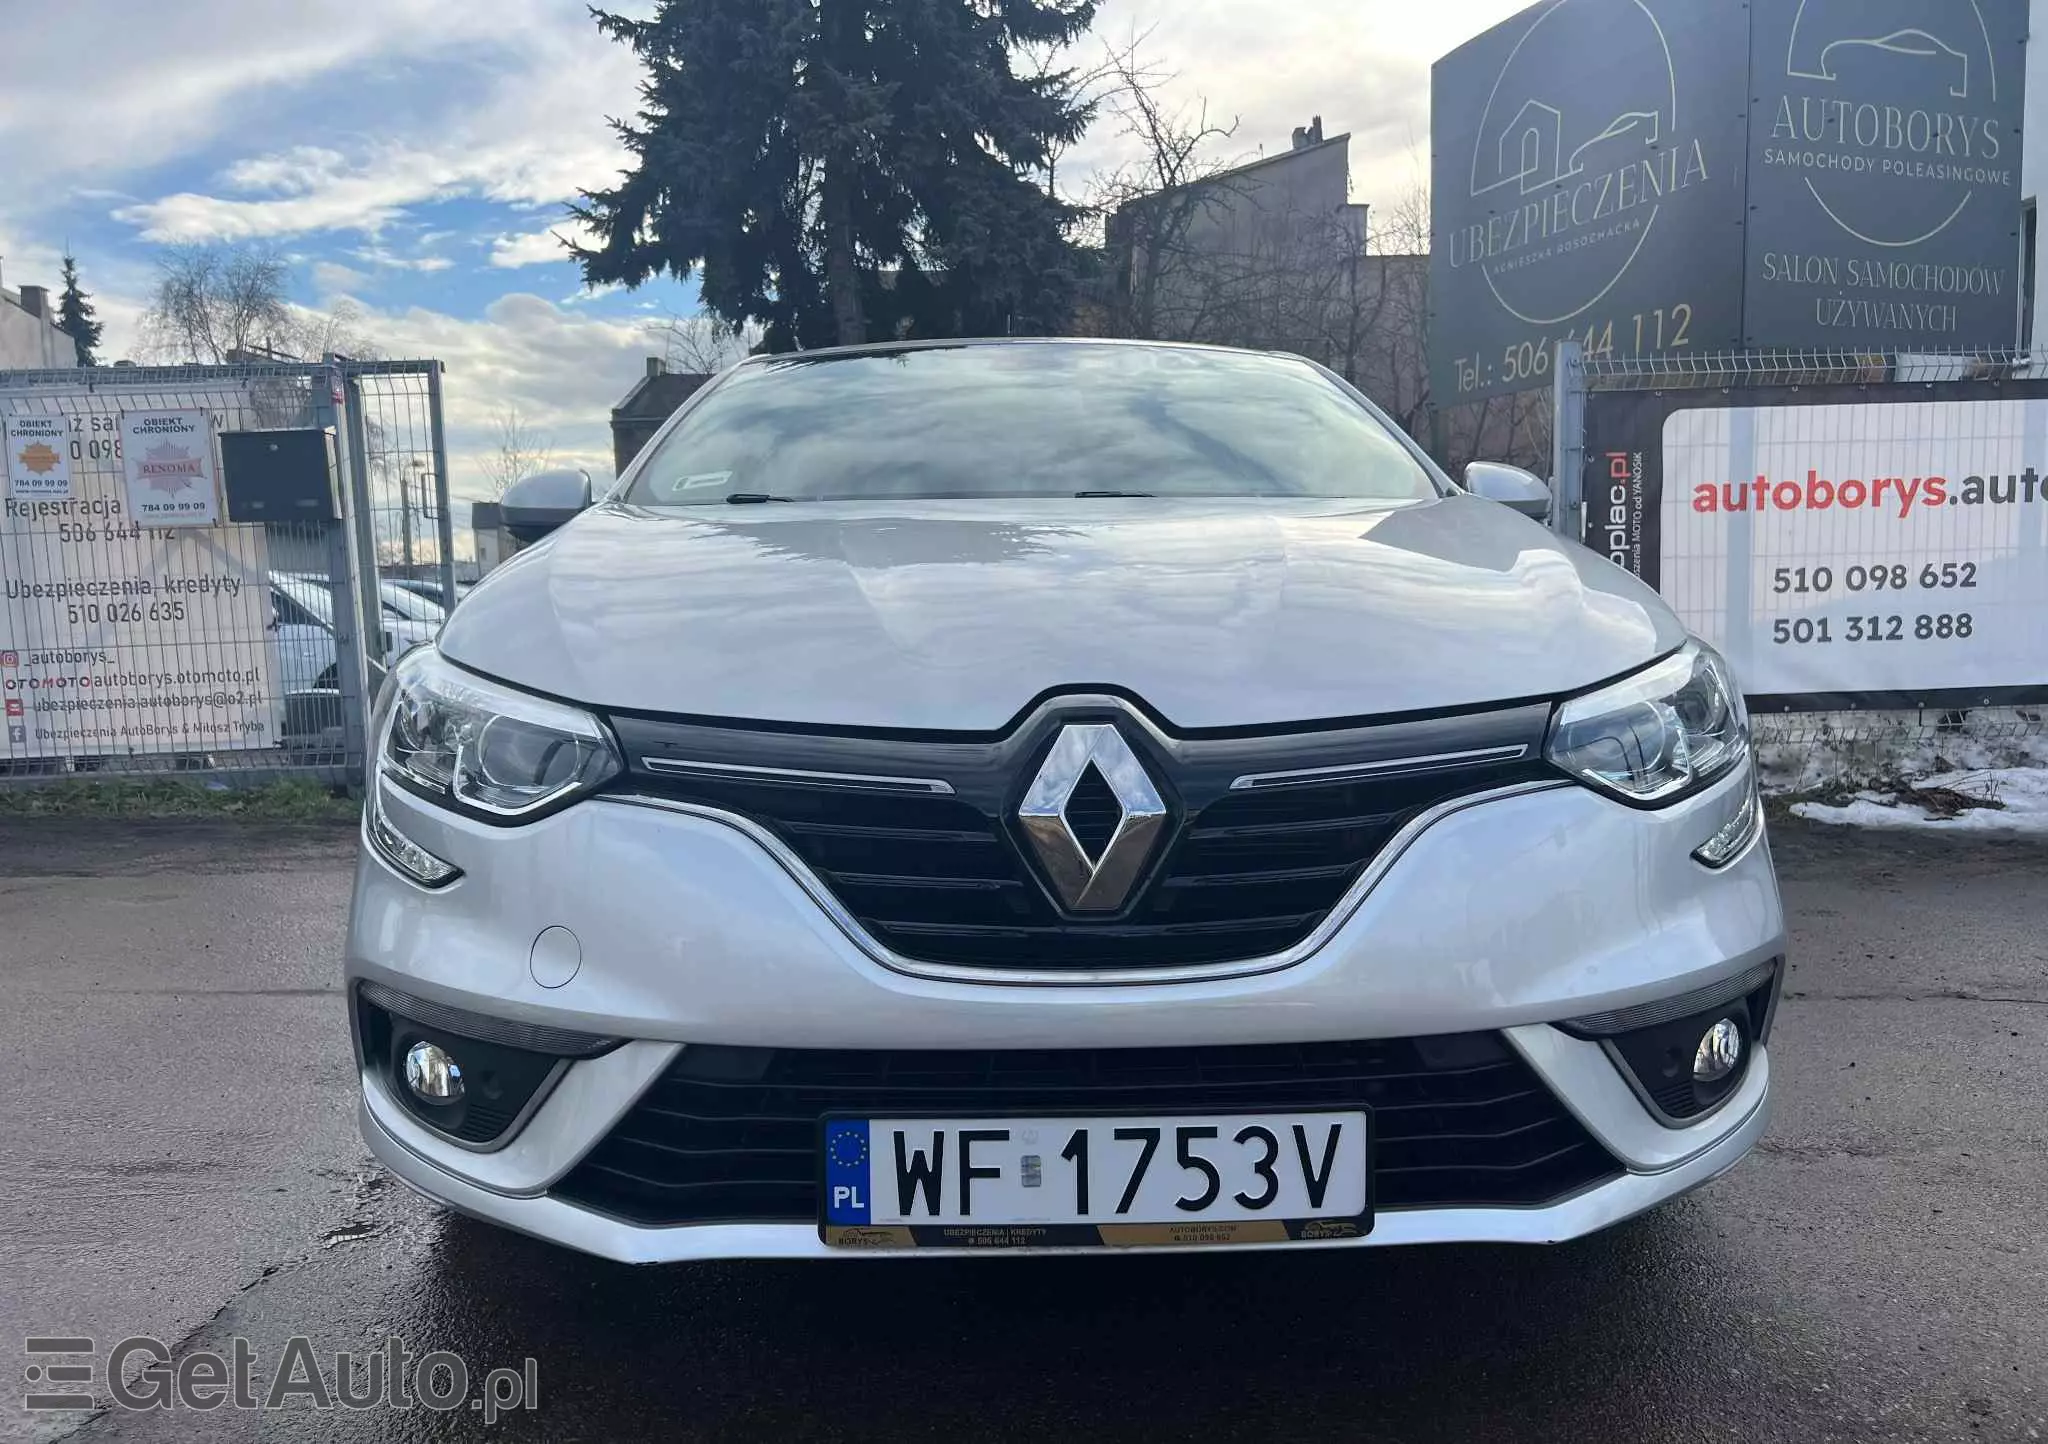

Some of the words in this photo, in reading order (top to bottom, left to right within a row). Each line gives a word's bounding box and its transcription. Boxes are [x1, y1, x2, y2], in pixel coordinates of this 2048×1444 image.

[1771, 95, 2000, 159] AUTOBORYS
[1764, 149, 1874, 173] SAMOCHODY
[1883, 160, 2012, 186] POLEASINGOWE
[1450, 138, 1708, 268] UBEZPIECZENIA
[1763, 253, 1839, 284] SALON
[1846, 259, 2005, 295] SAMOCHODÓW
[1816, 290, 1958, 331] UŻYWANYCH
[1454, 353, 1493, 392] Tel.:
[1501, 337, 1549, 383] 506
[1568, 320, 1614, 361] 44
[1632, 304, 1692, 352] 112
[11, 429, 63, 437] CHRONIONY
[20, 420, 52, 428] OBIEKT
[132, 425, 195, 434] CHRONIONY
[144, 417, 183, 426] OBIEKT
[143, 464, 196, 474] RENOMA
[1632, 452, 1643, 494] YANOSIK
[5, 495, 121, 520] Rejestracja
[142, 504, 160, 512] 784
[163, 503, 175, 511] 09
[178, 503, 190, 511] 99
[193, 502, 206, 511] 09
[1604, 452, 1631, 568] oplac.pl
[60, 523, 96, 542] 506
[104, 522, 140, 541] 644
[1632, 510, 1642, 542] MOTO
[164, 574, 241, 598] kredyty
[1773, 566, 1833, 593] 510
[1845, 563, 1907, 591] 098
[1919, 561, 1978, 588] 652
[68, 604, 99, 624] 510
[107, 602, 141, 622] 026
[150, 601, 185, 621] 635
[1772, 618, 1832, 645] 501
[1845, 616, 1904, 642] 312
[1914, 612, 1973, 639] 888
[24, 650, 115, 666] _autoborys_
[5, 676, 91, 690] OTOMOTO
[94, 667, 260, 688] autoborys.otomoto.pl
[36, 726, 116, 740] Ubezpieczenia
[121, 724, 177, 738] AutoBorys
[182, 722, 189, 734] &
[233, 721, 264, 734] Tryba
[893, 1129, 1010, 1217] WF
[1061, 1123, 1344, 1216] 1753V
[834, 1186, 865, 1209] PL
